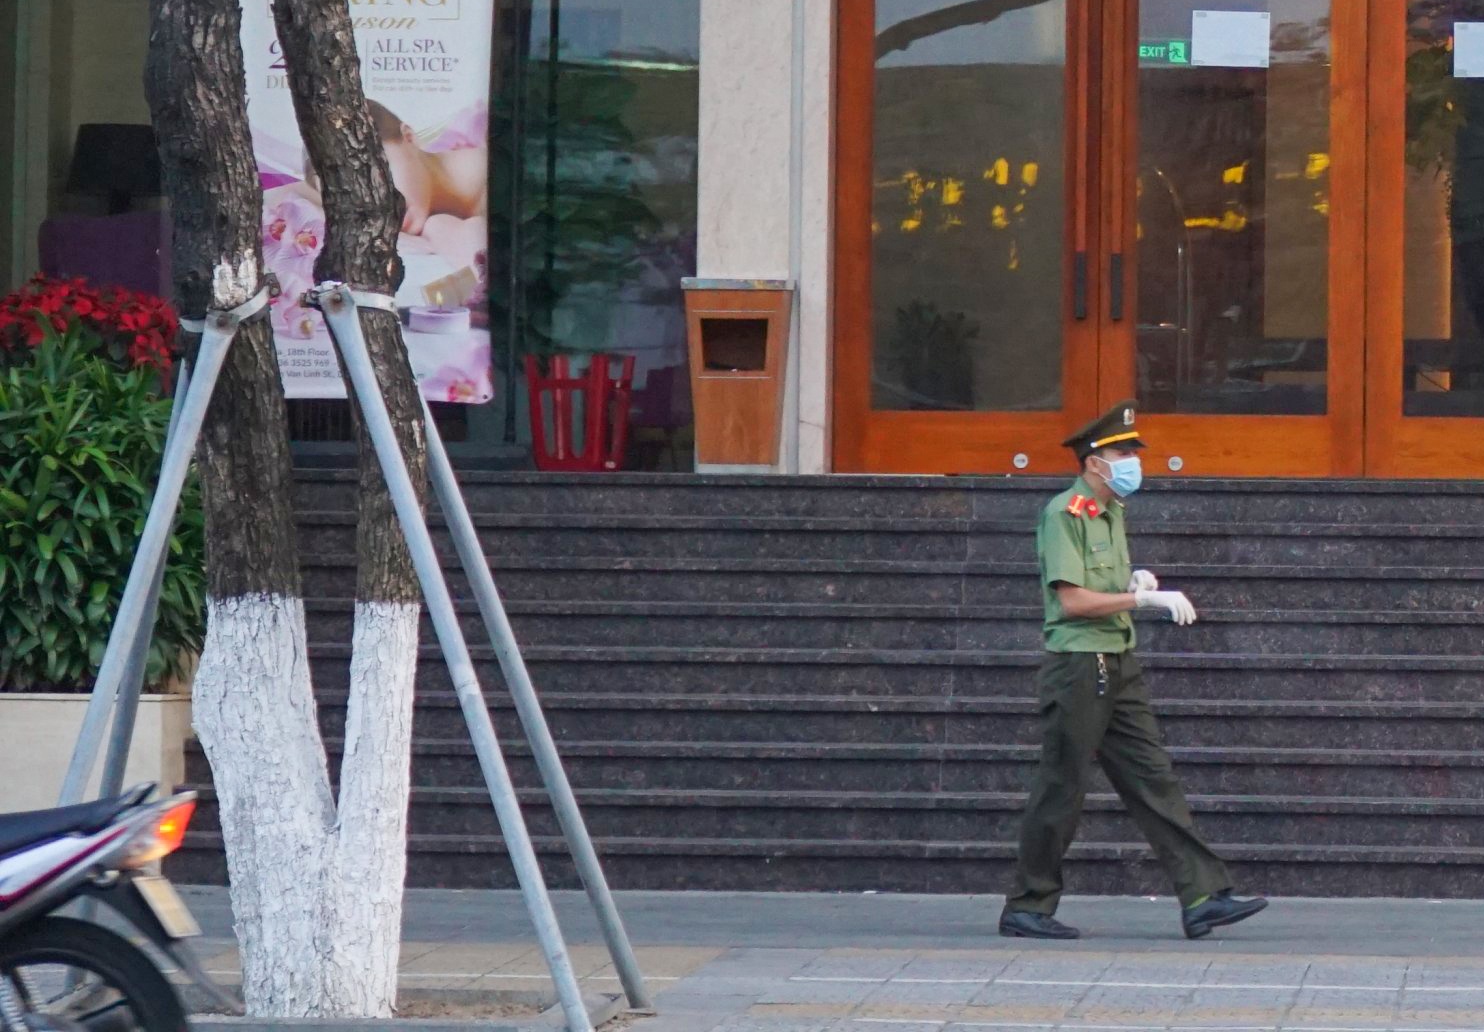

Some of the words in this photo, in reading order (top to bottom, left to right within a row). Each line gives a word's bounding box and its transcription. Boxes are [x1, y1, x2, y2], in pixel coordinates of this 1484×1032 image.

[372, 39, 409, 53] ALL
[413, 40, 446, 54] SPA
[1139, 46, 1166, 57] EXIT
